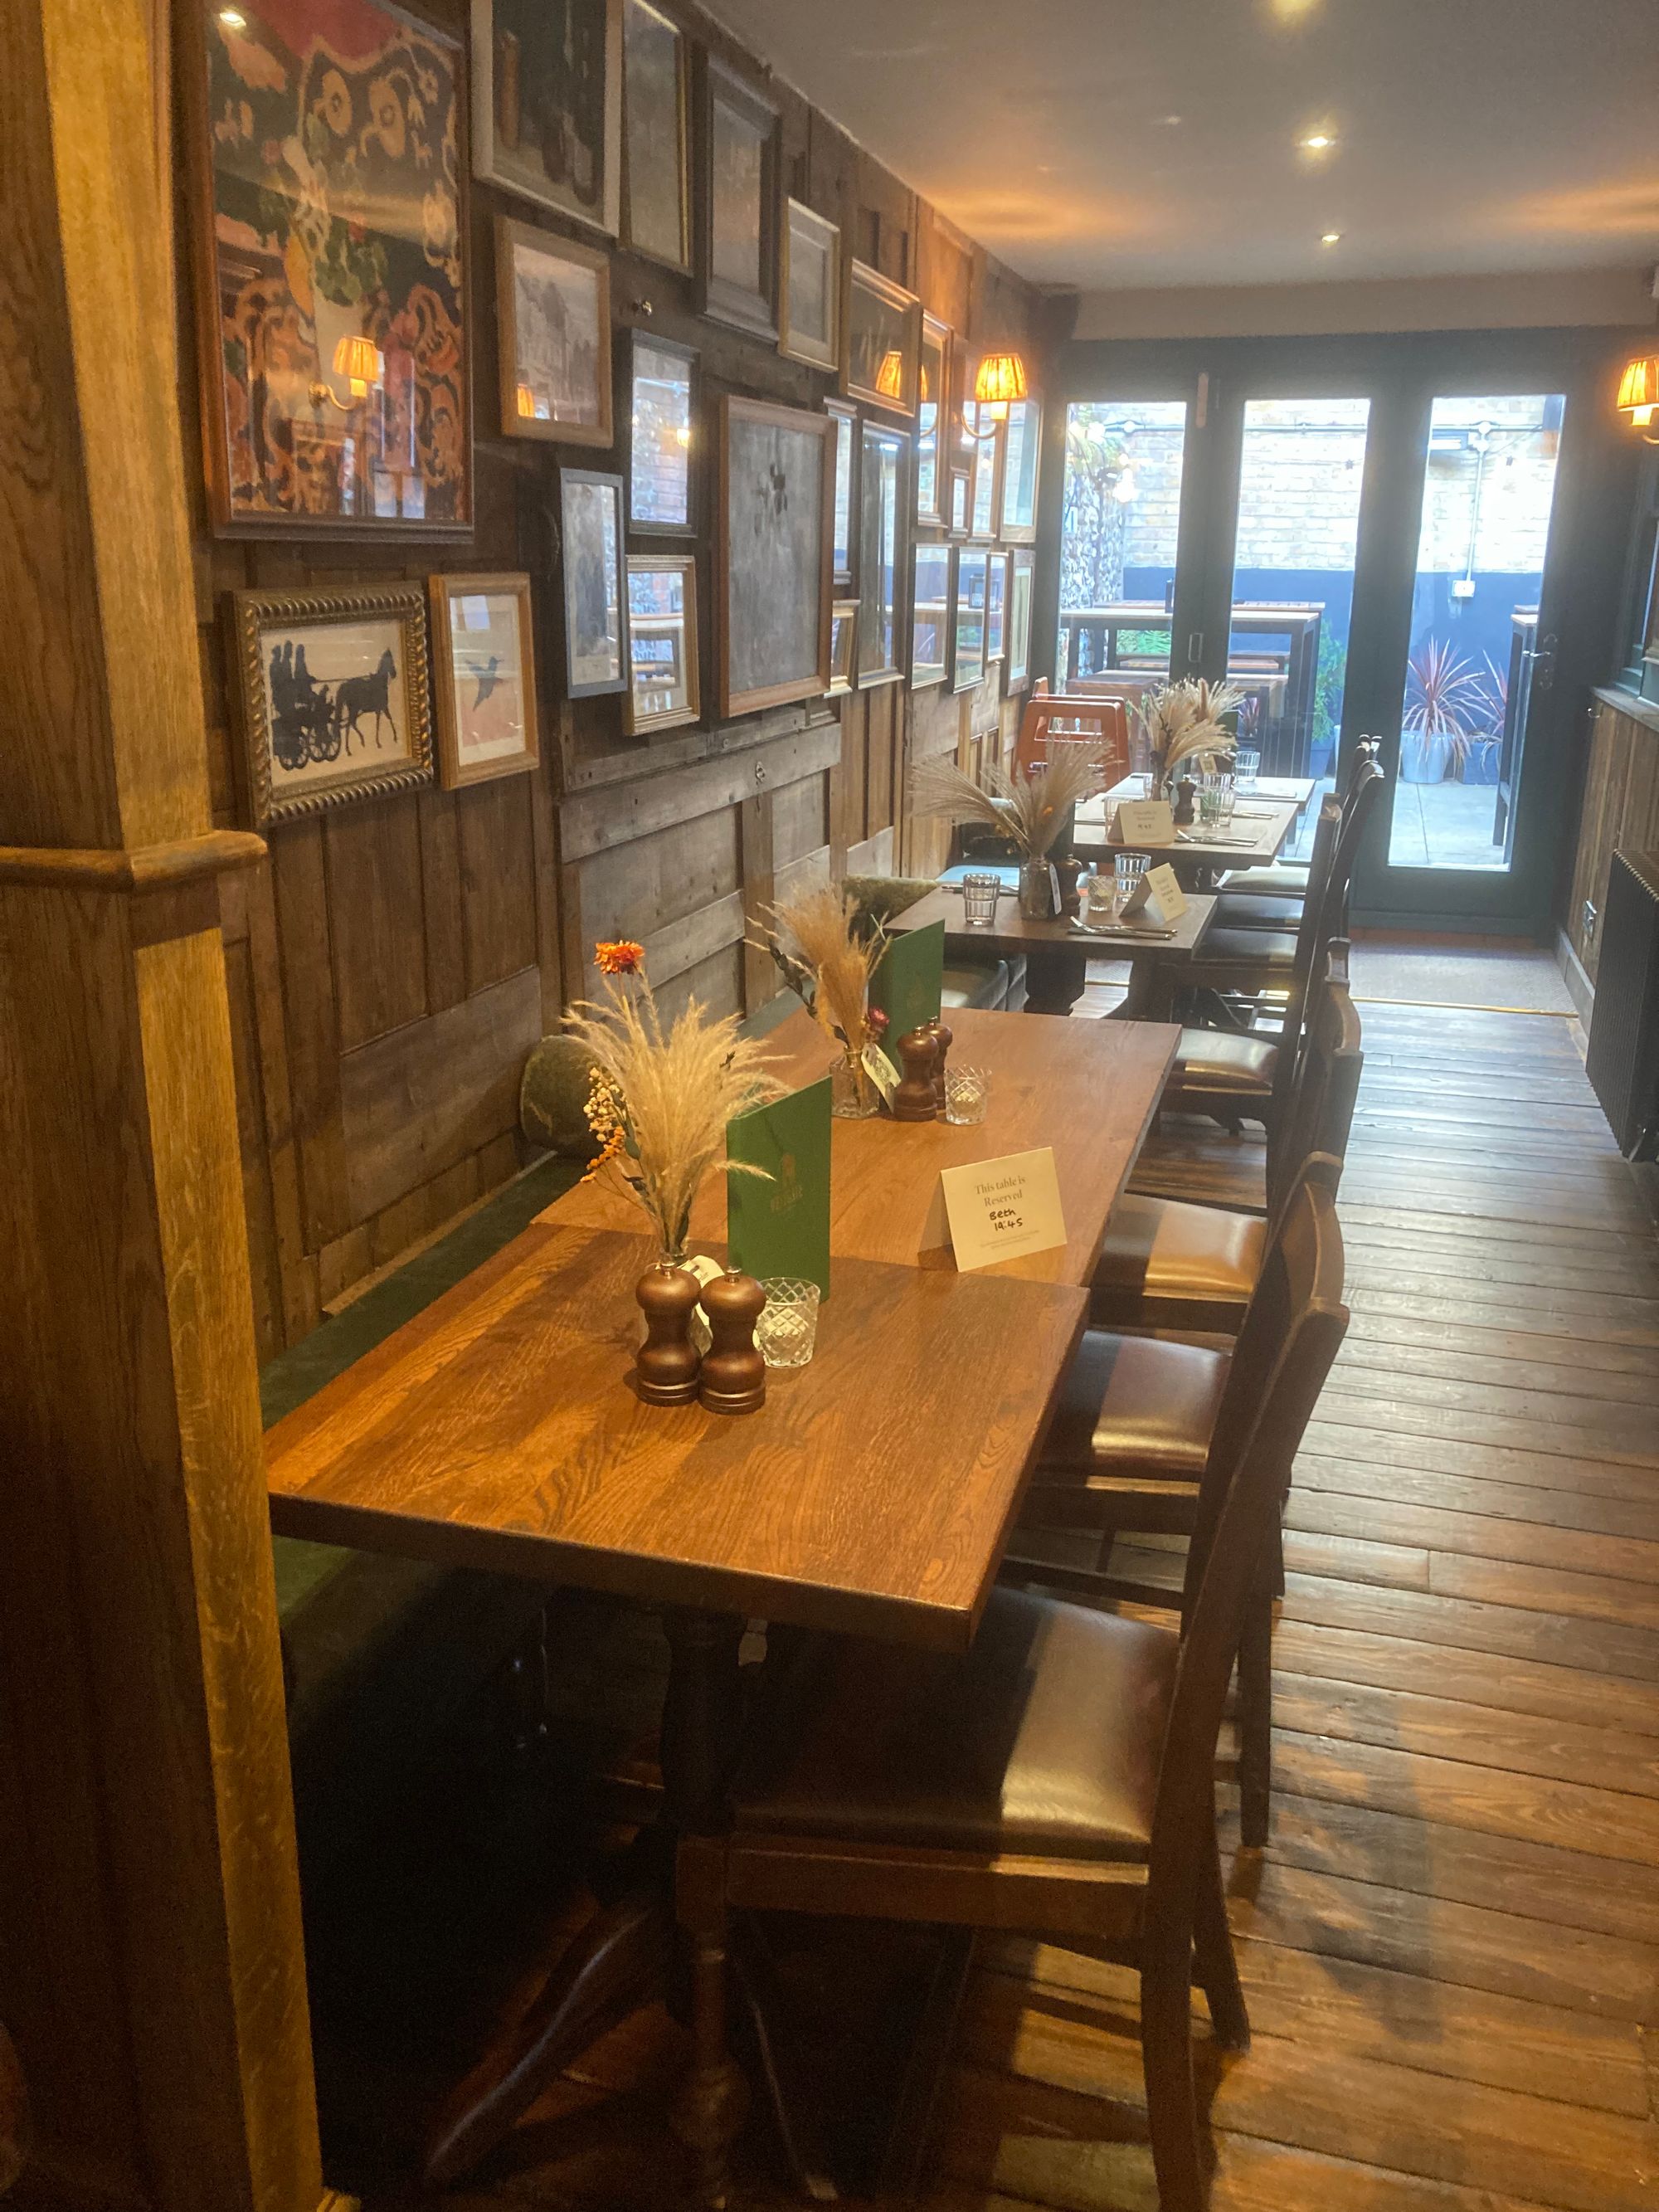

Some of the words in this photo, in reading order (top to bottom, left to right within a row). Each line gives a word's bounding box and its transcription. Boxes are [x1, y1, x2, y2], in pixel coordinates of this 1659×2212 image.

[975, 1183, 995, 1195] This
[995, 1177, 1017, 1190] table
[1018, 1175, 1026, 1184] is
[984, 1189, 1023, 1207] Reserved
[989, 1208, 1016, 1220] Beth
[995, 1217, 1023, 1231] 19:45
